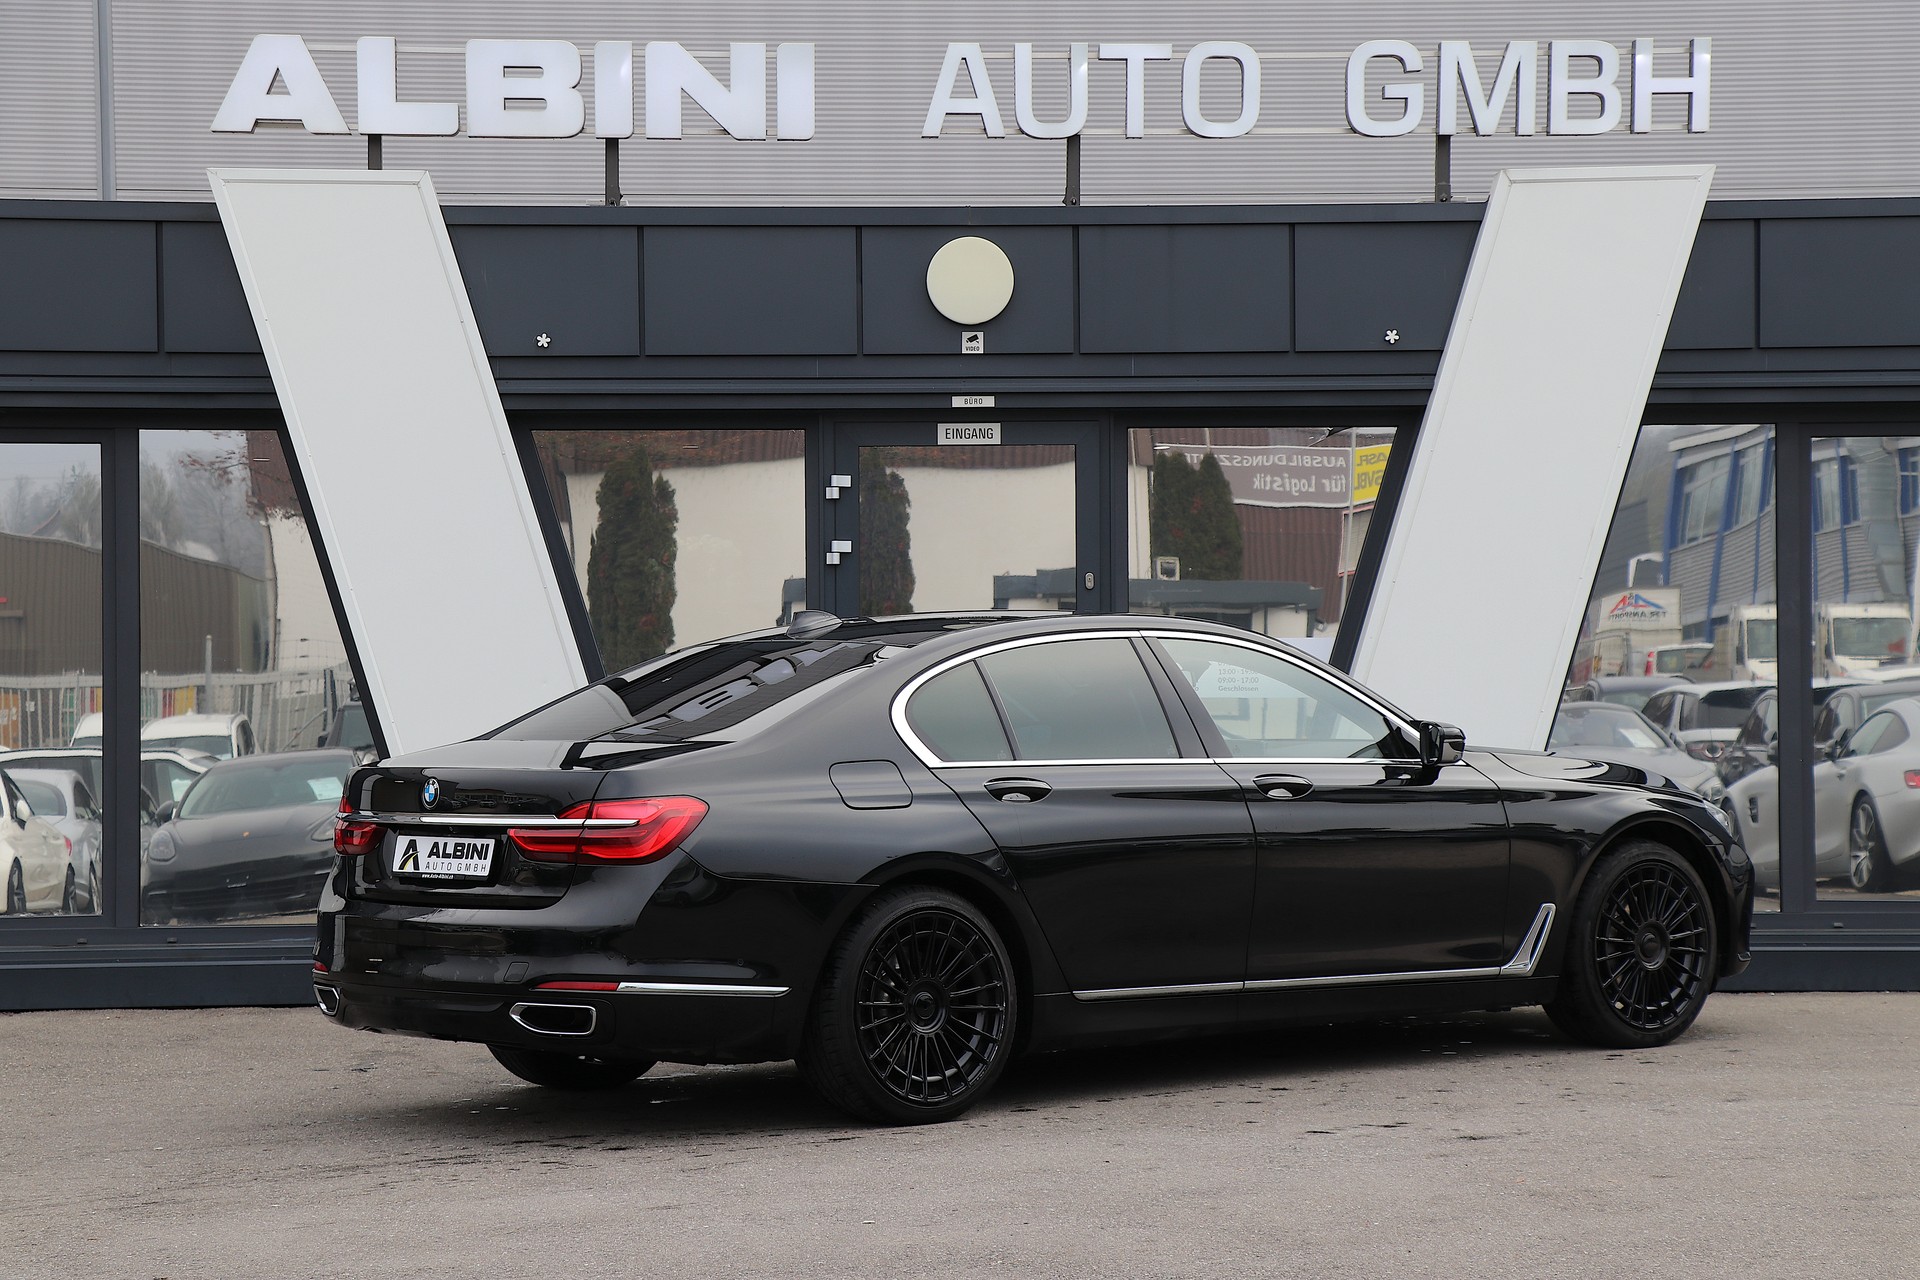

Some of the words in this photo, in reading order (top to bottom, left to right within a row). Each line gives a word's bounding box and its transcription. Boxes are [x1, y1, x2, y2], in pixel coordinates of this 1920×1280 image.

[210, 33, 816, 141] ALBINI
[921, 40, 1262, 139] AUTO
[1346, 37, 1713, 138] GMBH
[964, 397, 983, 405] BÜRO
[945, 427, 994, 440] EINGANG
[427, 841, 490, 860] ALBINI
[425, 861, 452, 871] AUTO
[456, 862, 487, 873] GMBH
